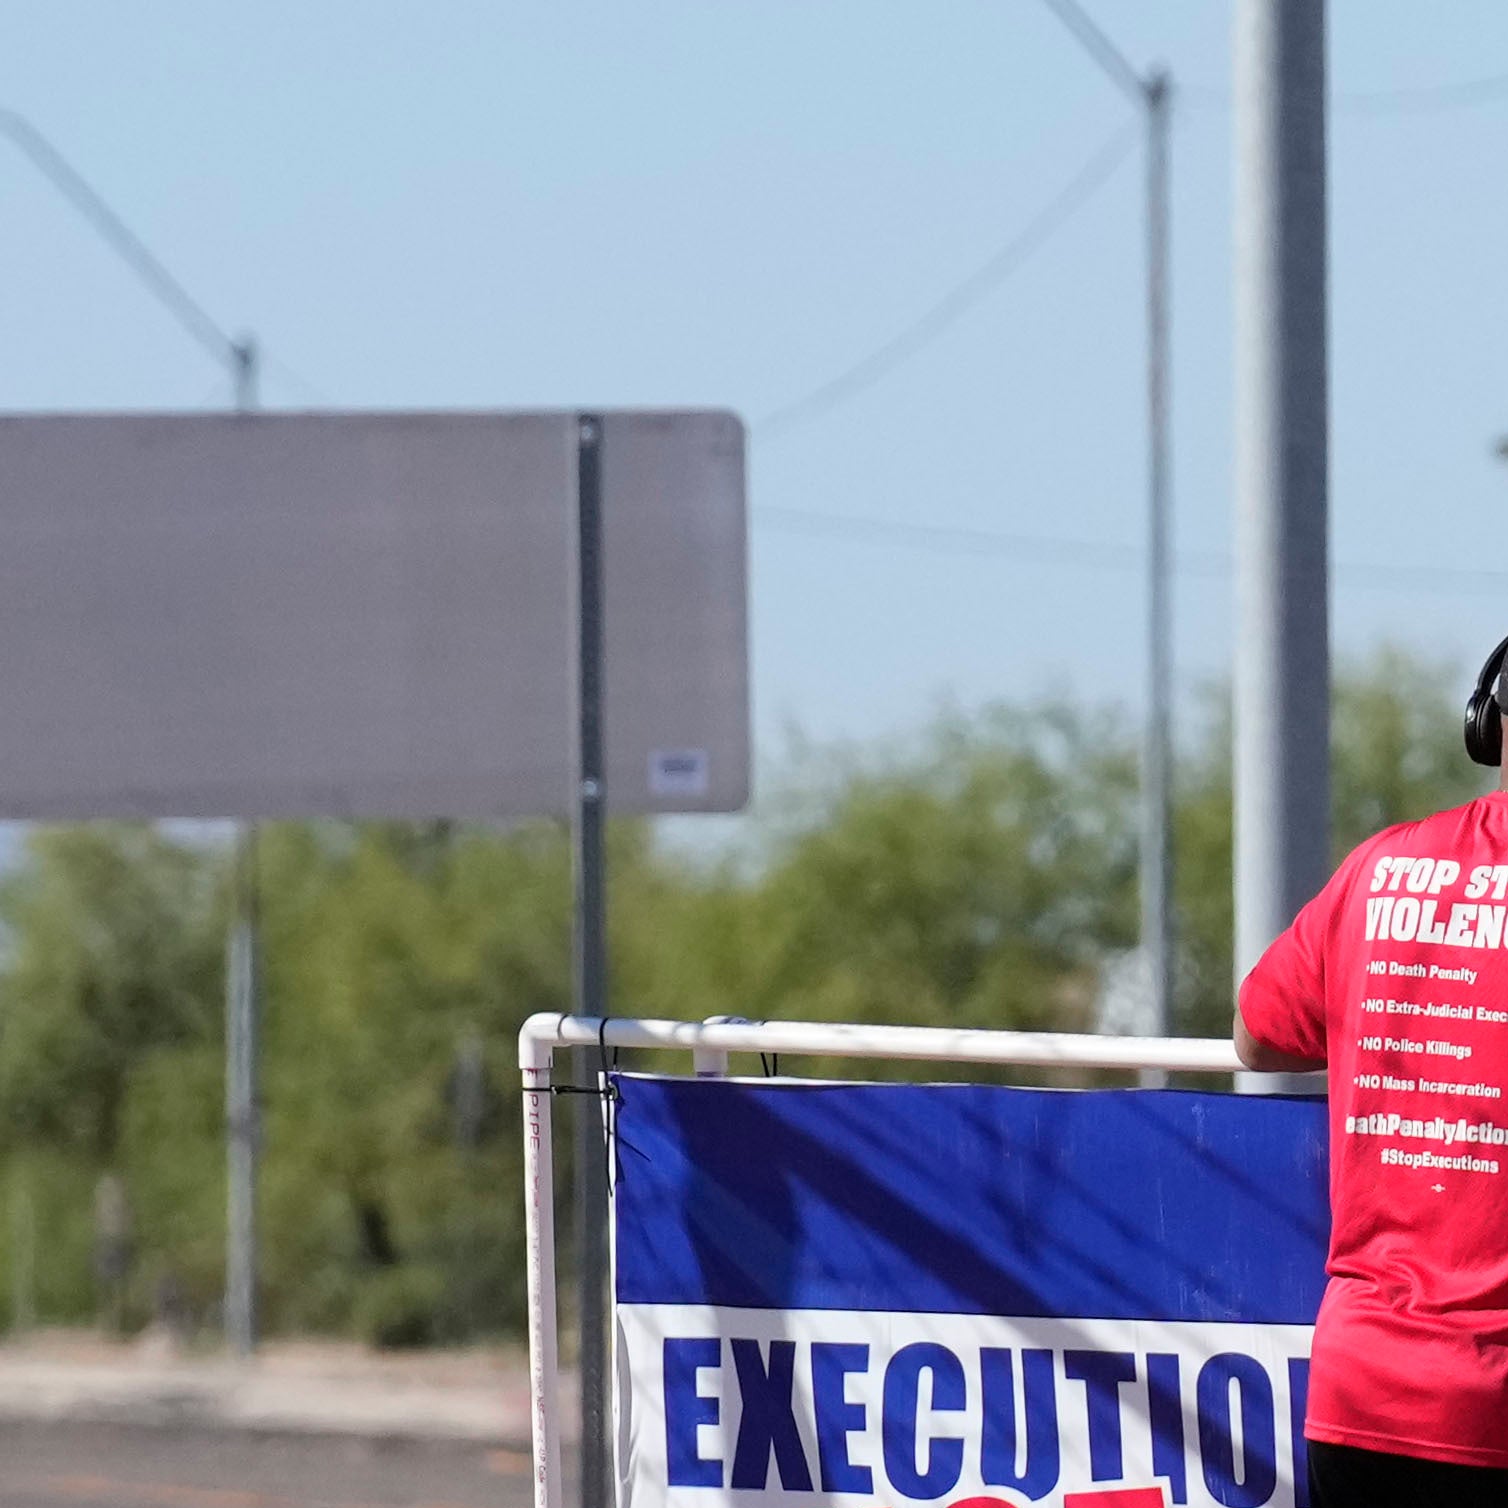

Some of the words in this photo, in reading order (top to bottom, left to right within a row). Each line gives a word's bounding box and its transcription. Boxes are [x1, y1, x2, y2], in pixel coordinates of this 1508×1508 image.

[1370, 856, 1460, 894] STOP
[1389, 961, 1427, 978] Death
[1429, 965, 1478, 985] Penalty
[1386, 1000, 1473, 1020] Extra-Judicial
[1384, 1038, 1424, 1053] Police
[1426, 1041, 1472, 1060] Killings
[1383, 1076, 1415, 1091] Mass
[1419, 1078, 1501, 1099] Incarceration
[1381, 1148, 1499, 1174] #StopExecutions
